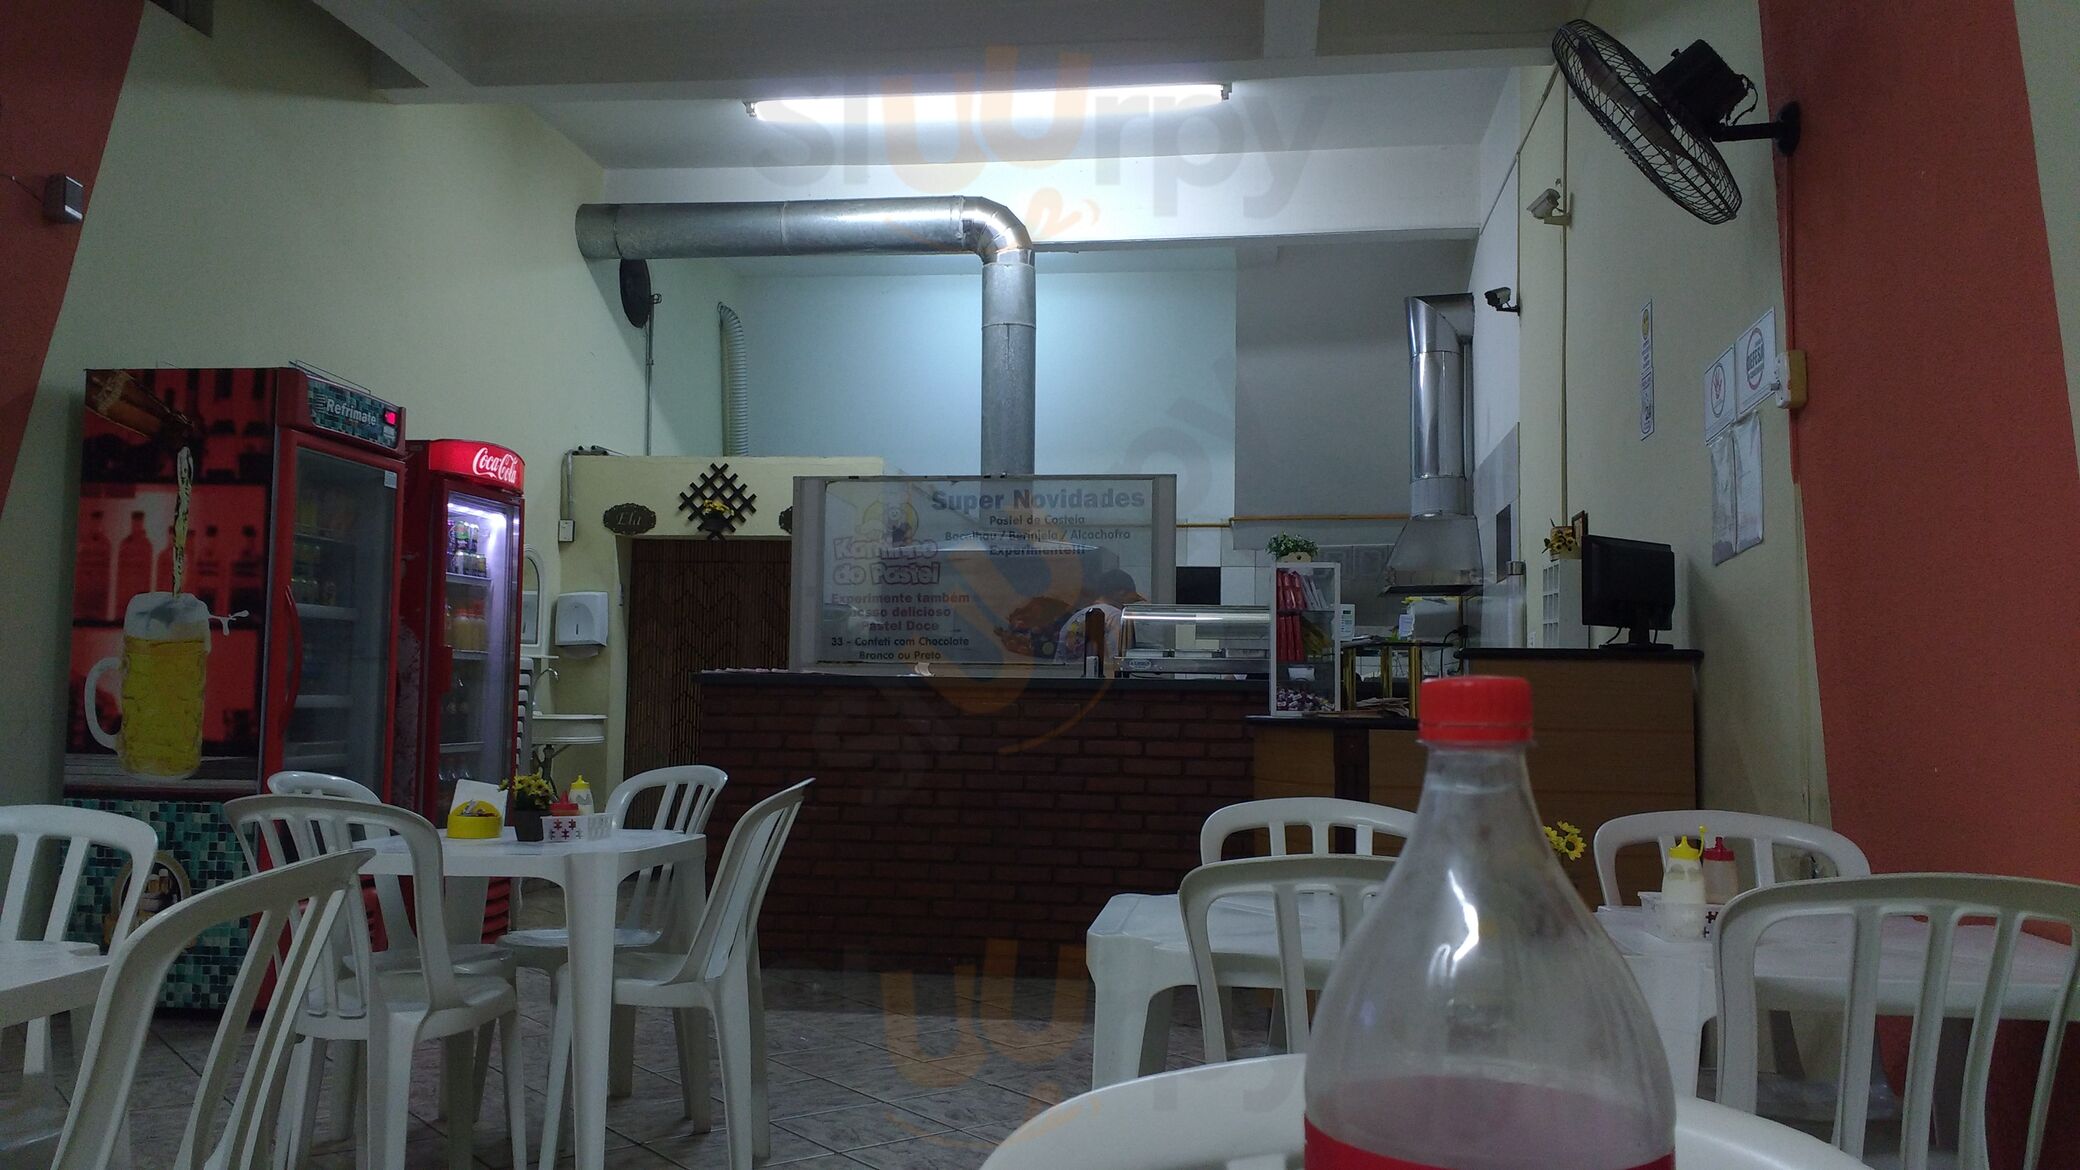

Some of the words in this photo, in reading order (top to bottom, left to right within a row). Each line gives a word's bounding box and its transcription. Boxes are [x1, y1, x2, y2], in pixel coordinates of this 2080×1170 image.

[326, 399, 377, 425] Refrimate
[472, 447, 517, 484] Coca-Cola
[932, 490, 1004, 515] Super
[1013, 488, 1145, 509] Novidades
[989, 515, 1023, 526] Pastel
[1027, 514, 1040, 525] de
[1044, 514, 1085, 525] Costela
[1071, 530, 1131, 541] Alcachofra
[833, 563, 866, 585] do
[869, 561, 940, 585] Pastel
[832, 593, 912, 605] Experimente
[917, 592, 970, 603] também
[892, 607, 951, 618] delicioso
[906, 621, 939, 631] Doce
[831, 637, 843, 647] 33
[854, 637, 891, 647] Confeti
[894, 638, 915, 647] com
[919, 636, 970, 647] Chocolate
[859, 651, 894, 661] Branco
[898, 652, 911, 661] ou
[914, 651, 941, 661] Preto
